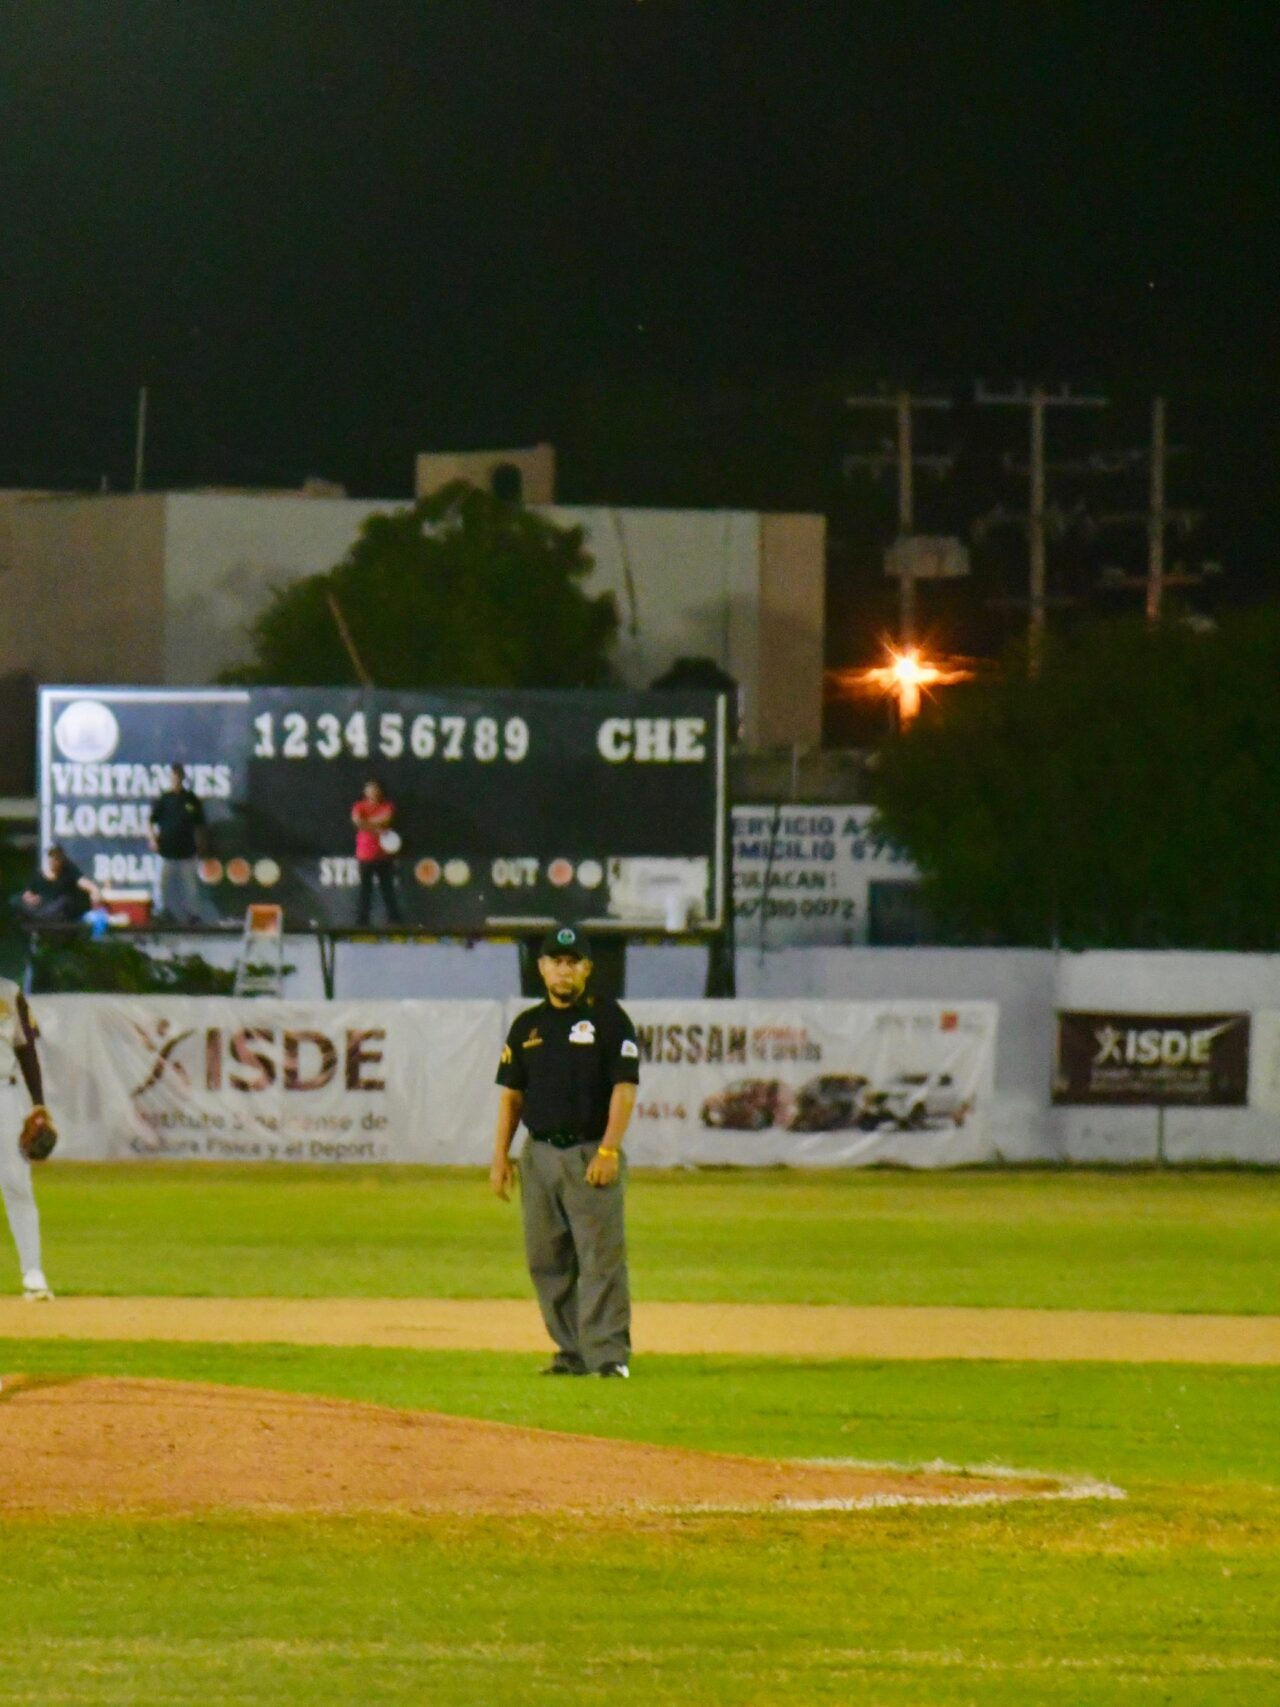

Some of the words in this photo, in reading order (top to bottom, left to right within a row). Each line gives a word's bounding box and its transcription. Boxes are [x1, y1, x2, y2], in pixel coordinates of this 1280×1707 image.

[596, 717, 707, 763] CHE
[492, 856, 541, 887] OUT
[206, 1027, 387, 1092] ISDE
[636, 1024, 747, 1064] NISSAN
[1125, 1028, 1211, 1065] ISDE
